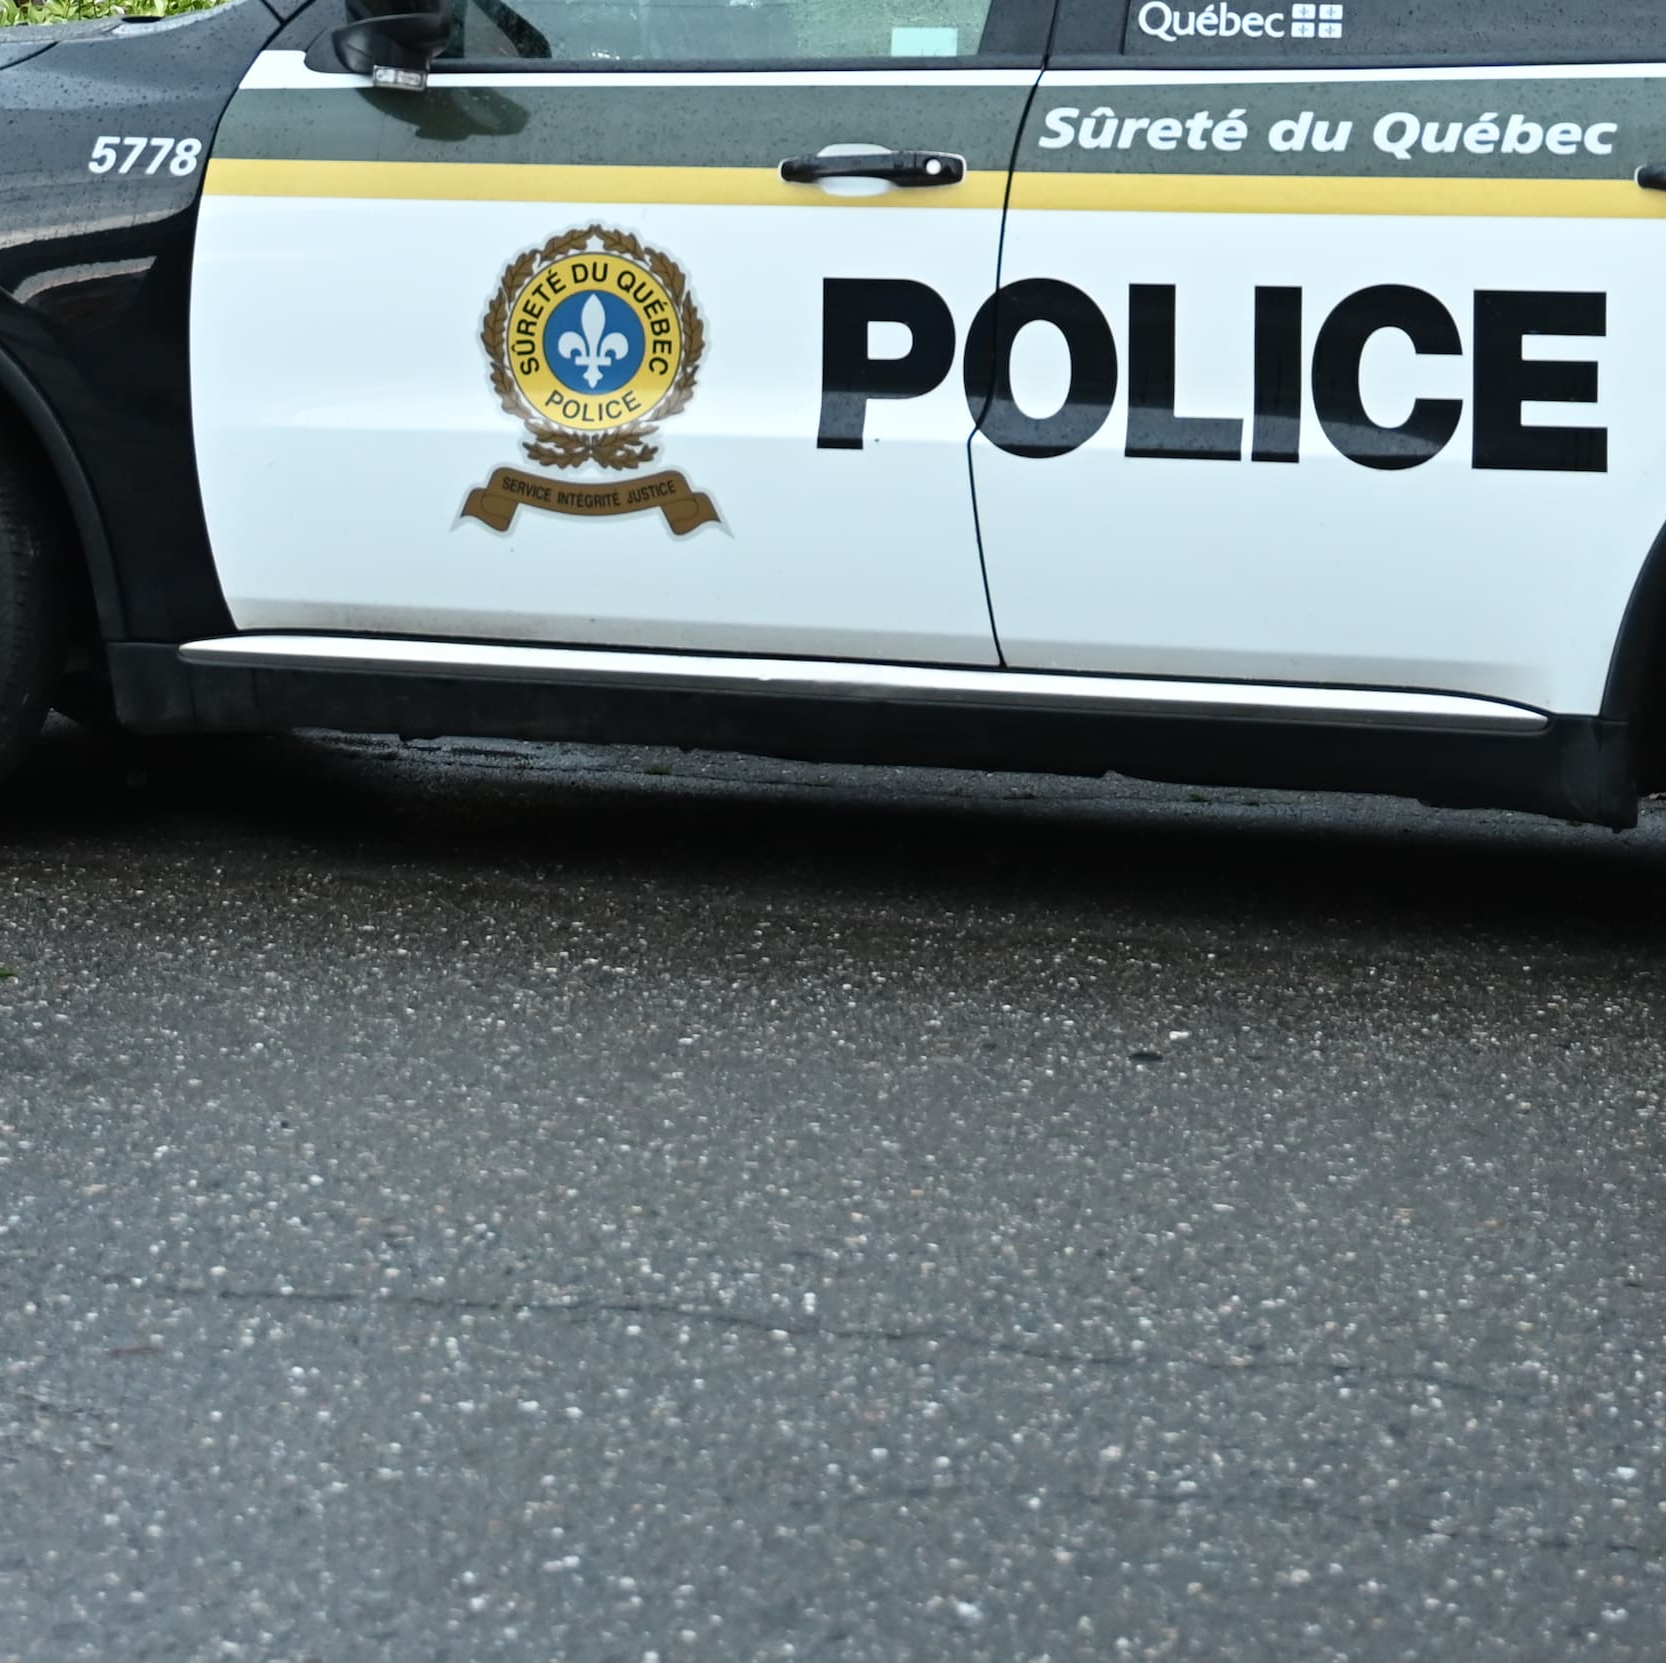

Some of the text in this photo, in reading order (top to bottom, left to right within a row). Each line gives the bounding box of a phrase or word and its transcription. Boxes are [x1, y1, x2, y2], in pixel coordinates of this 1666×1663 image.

[1137, 0, 1286, 42] Québec
[1038, 107, 1618, 161] Sûreté du Québec
[88, 135, 202, 176] 5778
[511, 261, 673, 376] SÛRETÉ DU QUÉBEC
[815, 276, 1608, 472] POLICE
[545, 389, 642, 422] POLICE
[501, 476, 676, 508] SERVICE INTÉGRITÉ JUSTICE
